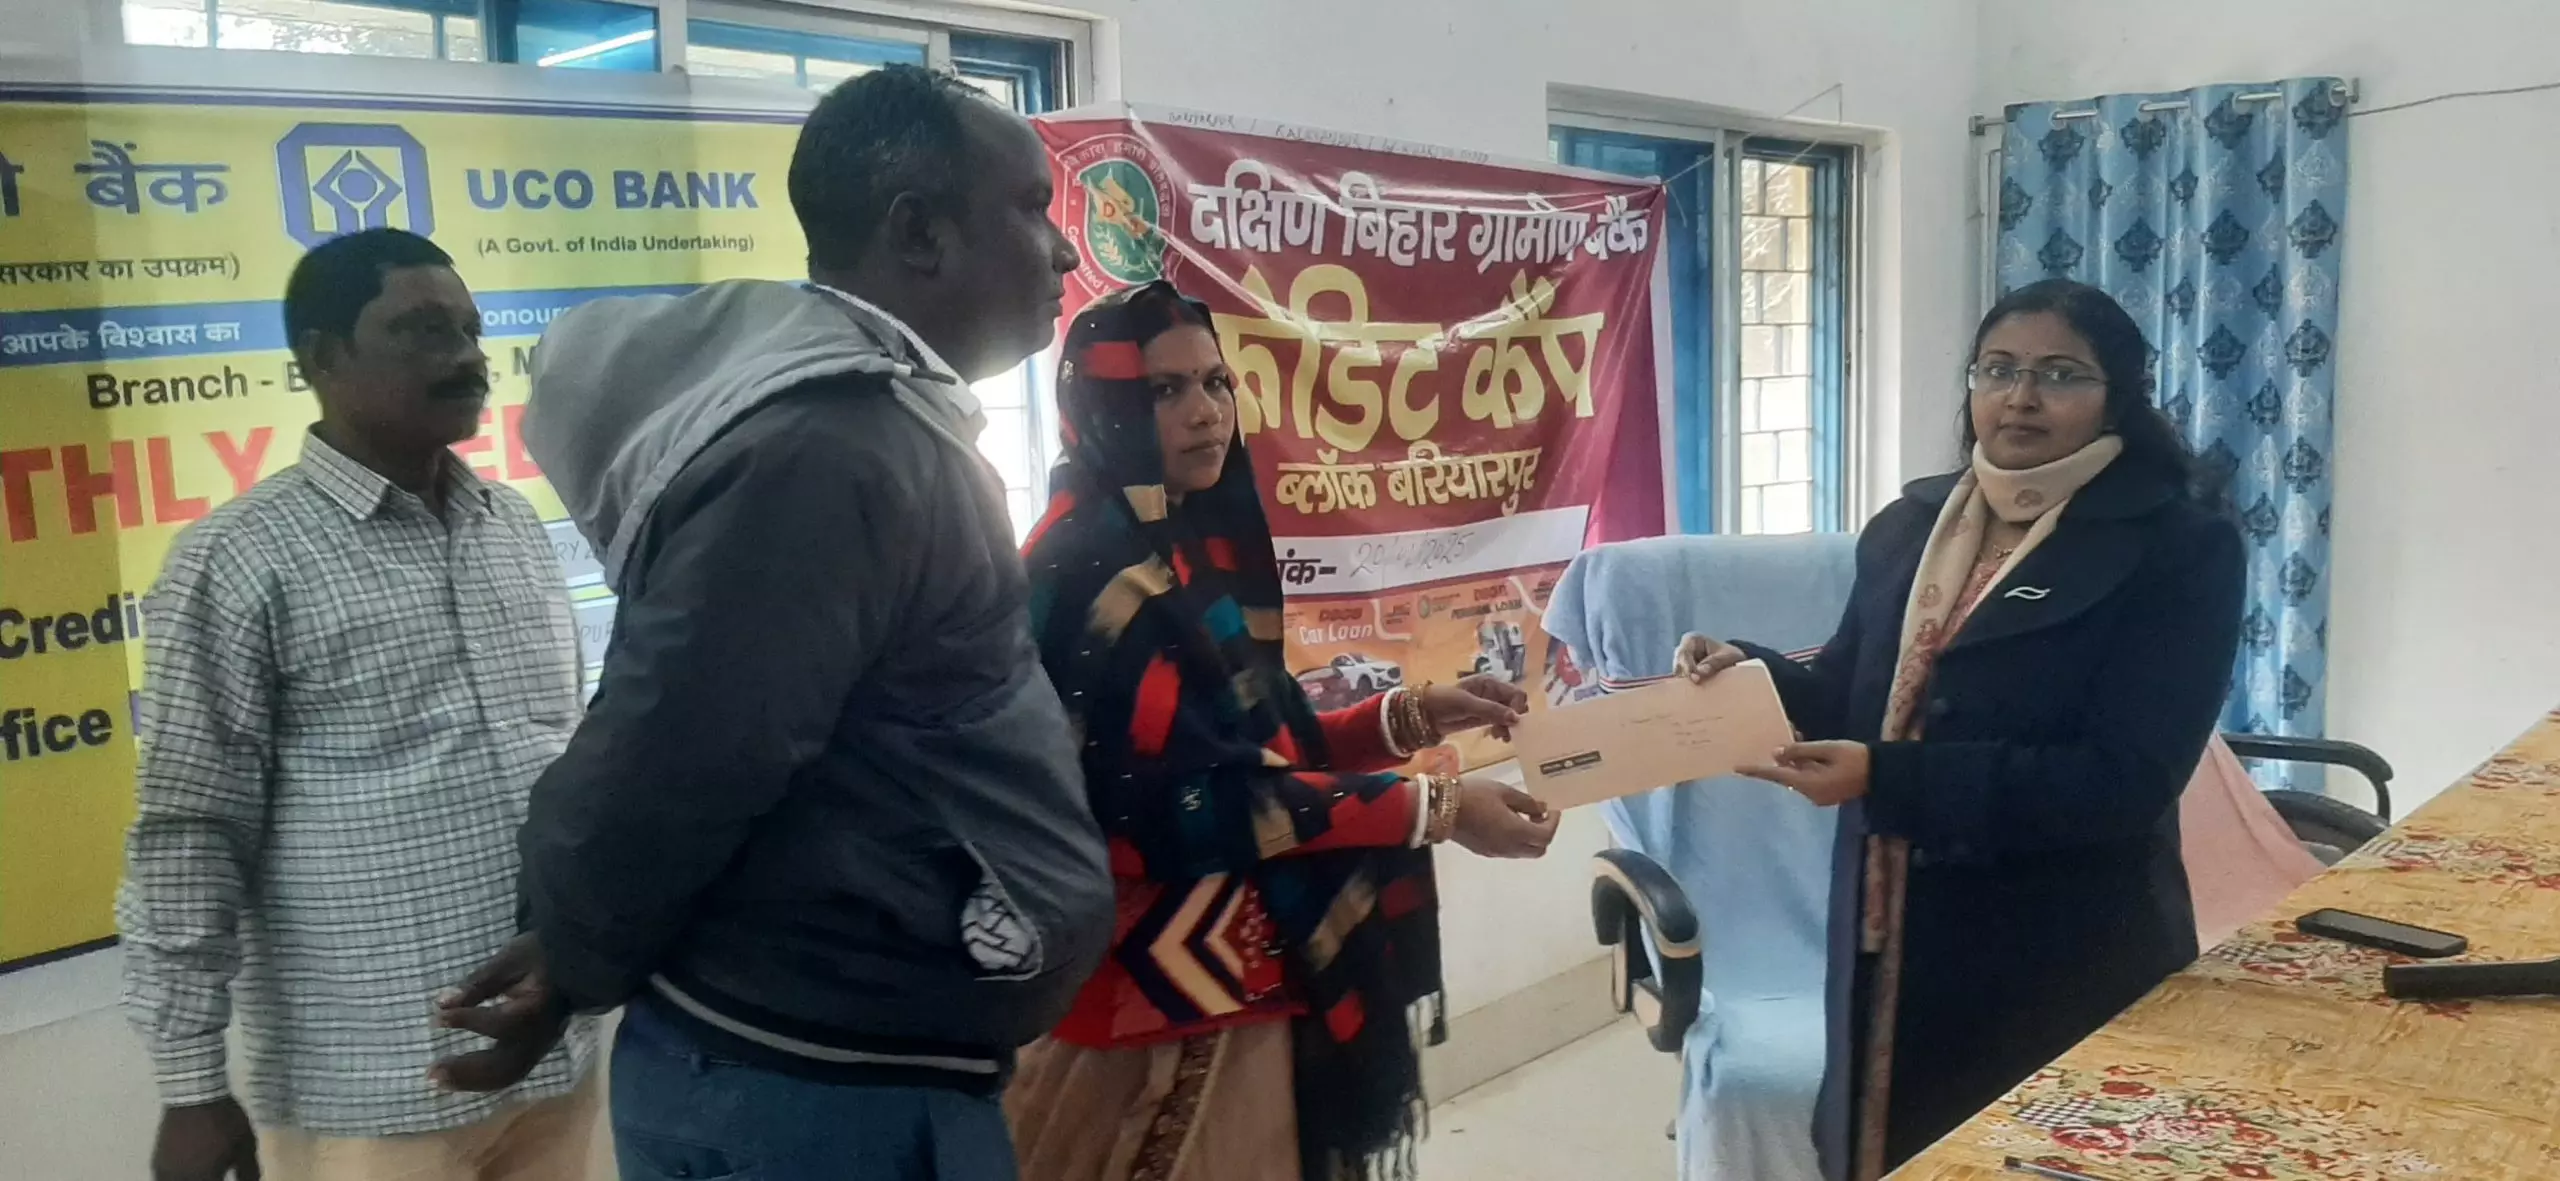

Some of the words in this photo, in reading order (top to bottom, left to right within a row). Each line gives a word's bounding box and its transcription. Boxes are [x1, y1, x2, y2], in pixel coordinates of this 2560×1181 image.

[73, 139, 231, 214] बैंक
[465, 168, 595, 210] UCO
[612, 170, 759, 210] BANK
[1188, 159, 1327, 255] दक्षिण
[1337, 171, 1464, 266] बिहार
[478, 238, 500, 258] (A
[506, 238, 560, 254] Govt.
[566, 236, 585, 252] of
[591, 236, 637, 252] India
[642, 233, 755, 252] Undertaking)
[97, 258, 134, 280] का
[2, 324, 90, 354] आपके
[98, 320, 197, 349] विश्वास
[204, 322, 241, 342] का
[87, 366, 249, 410] Branch
[1276, 447, 1376, 514] ब्लॉक
[0, 591, 140, 660] Credi
